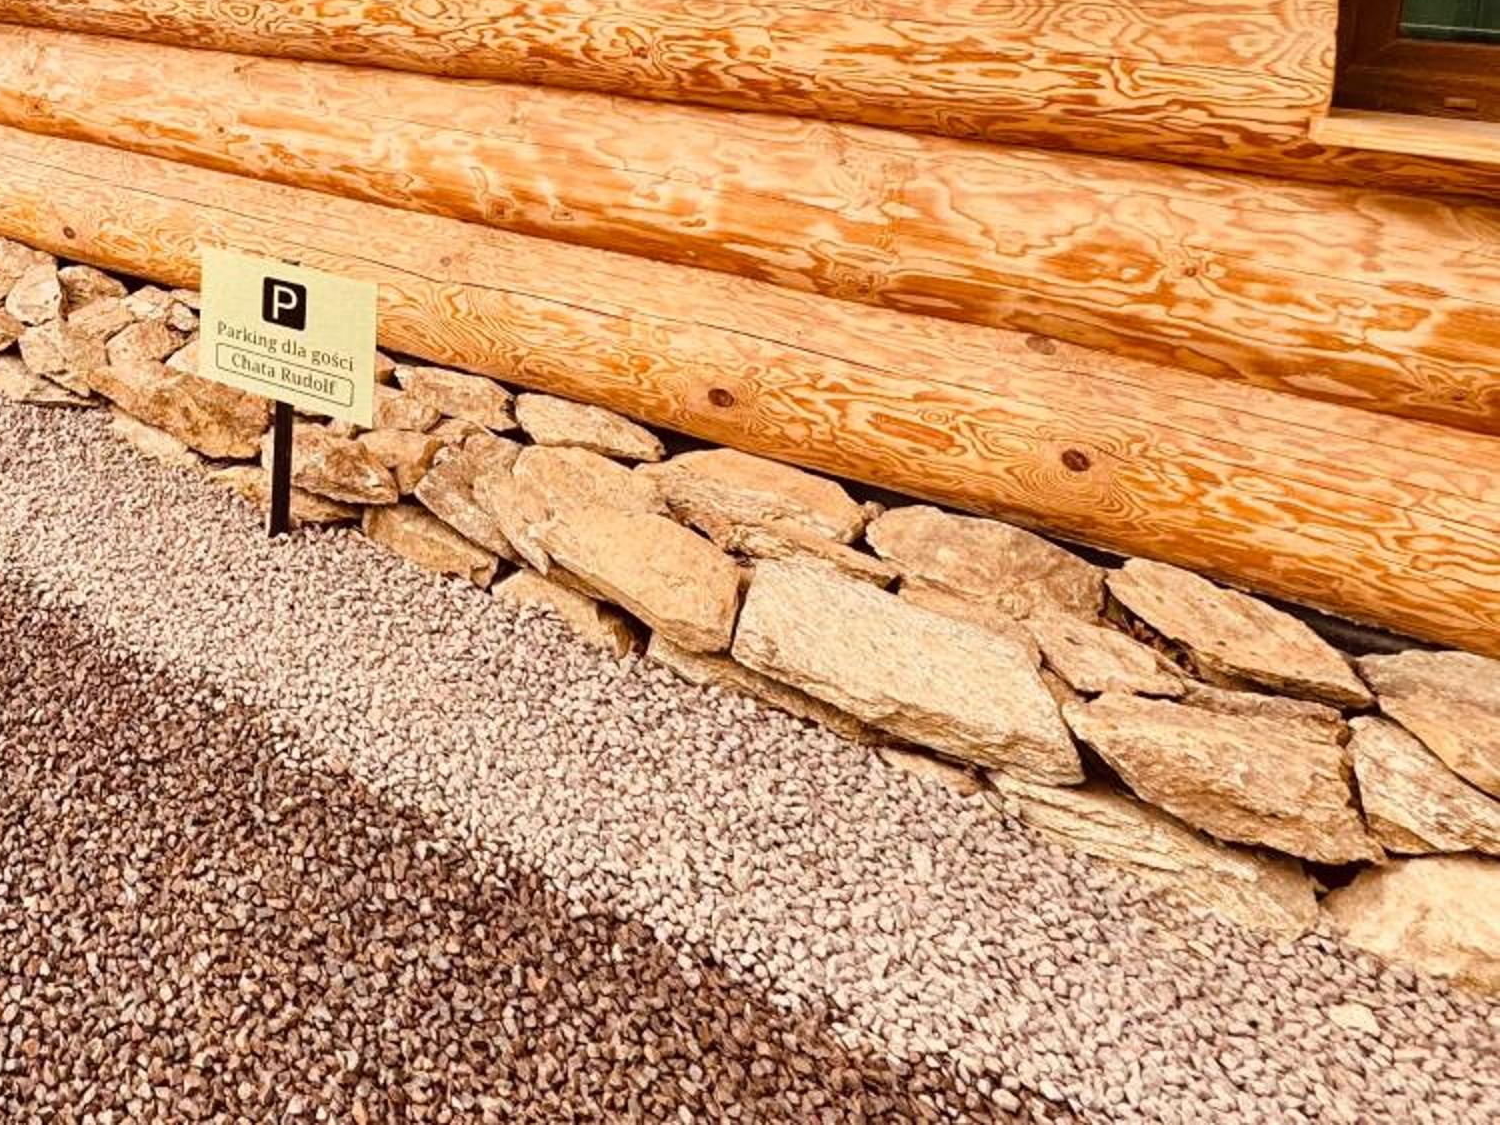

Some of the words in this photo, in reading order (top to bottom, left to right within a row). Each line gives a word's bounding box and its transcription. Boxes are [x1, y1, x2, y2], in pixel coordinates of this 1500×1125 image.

[217, 321, 277, 353] Parking
[281, 340, 307, 358] dla
[311, 349, 354, 372] gości
[231, 352, 275, 378] Chata
[281, 368, 336, 396] Rudolf
